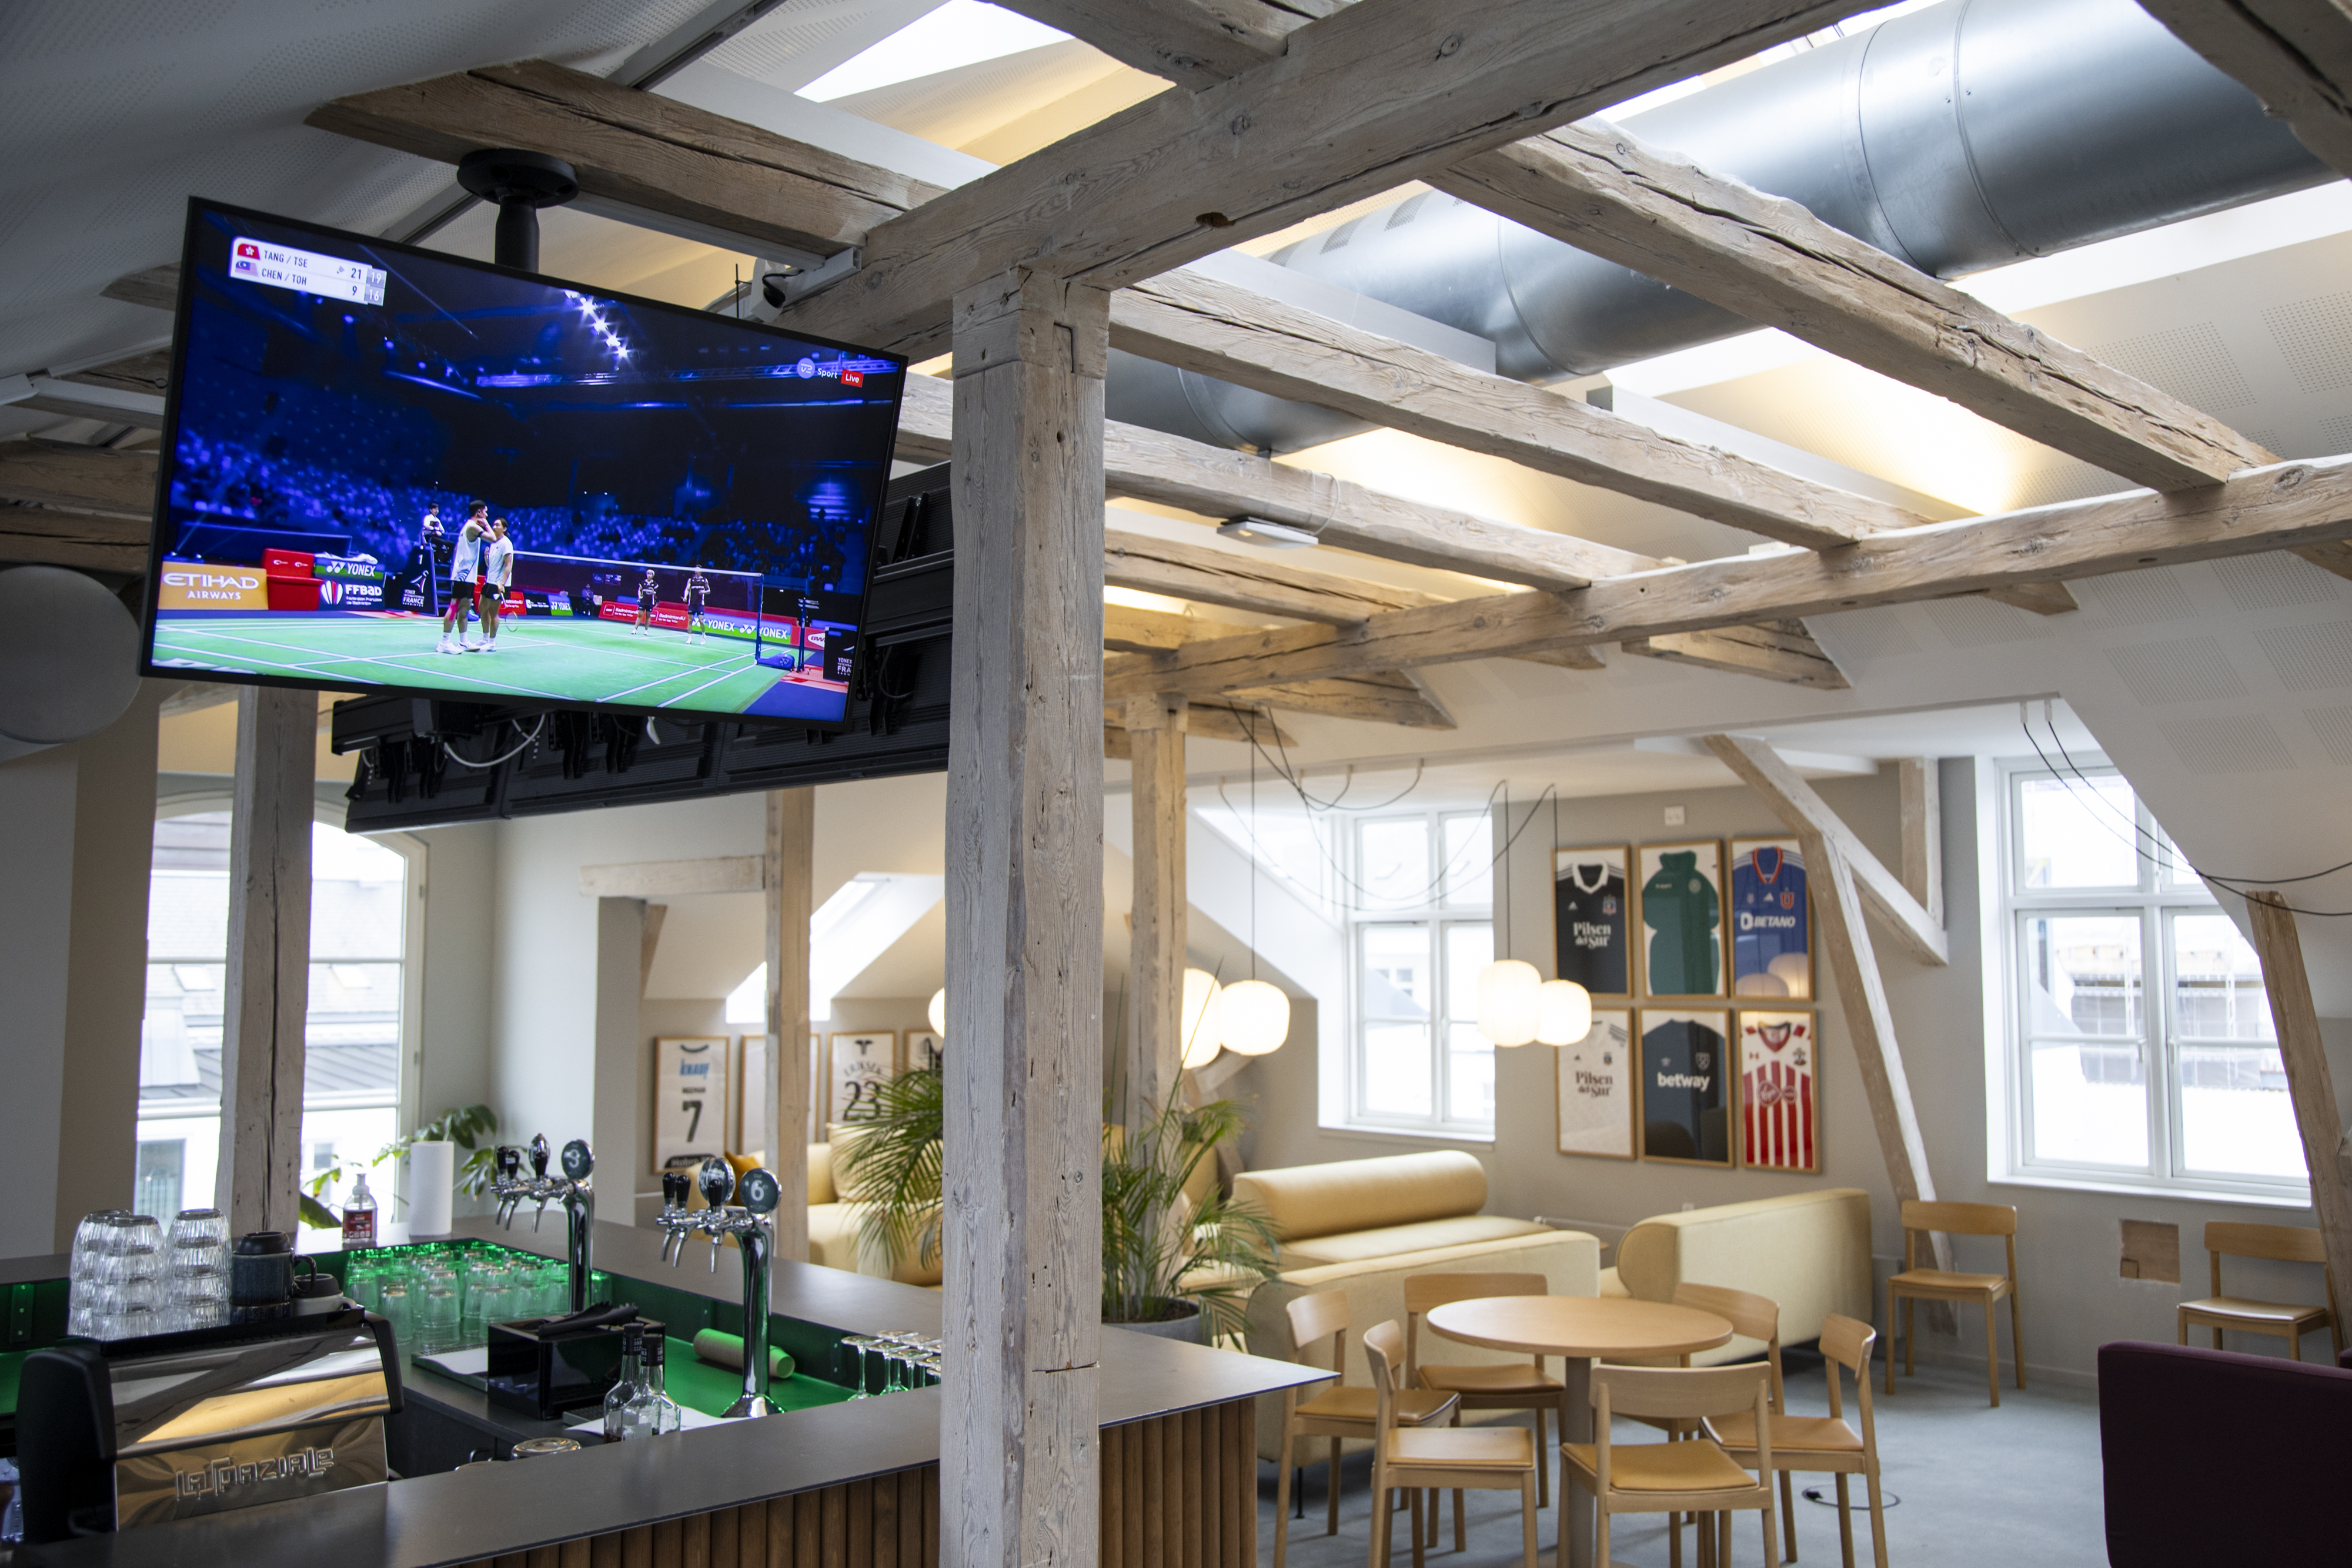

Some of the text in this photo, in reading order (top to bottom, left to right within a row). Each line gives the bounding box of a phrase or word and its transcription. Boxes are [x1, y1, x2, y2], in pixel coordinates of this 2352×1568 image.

[265, 250, 284, 263] TANG
[295, 256, 308, 268] TSE
[262, 268, 282, 280] CHEN
[292, 274, 307, 285] TOH
[351, 268, 362, 280] 21
[371, 272, 382, 284] 19
[352, 286, 358, 296] 9
[369, 289, 379, 301] 16
[817, 367, 837, 379] Sport
[845, 373, 860, 383] Live
[347, 562, 376, 577] YONEX
[163, 572, 259, 590] ETIHAD
[187, 590, 242, 600] AIRWAYS
[403, 596, 425, 605] FRANCE
[557, 601, 572, 611] YONEX
[707, 618, 735, 632] YONEX
[759, 626, 788, 640] YONEX
[1573, 921, 1611, 936] Pilsen
[1754, 915, 1796, 928] BETANO
[1576, 1071, 1613, 1085] Pilsen
[1657, 1071, 1710, 1092] betway
[844, 1081, 881, 1121] 23
[682, 1100, 703, 1143] 7
[568, 1148, 580, 1169] 3
[750, 1179, 764, 1202] 6
